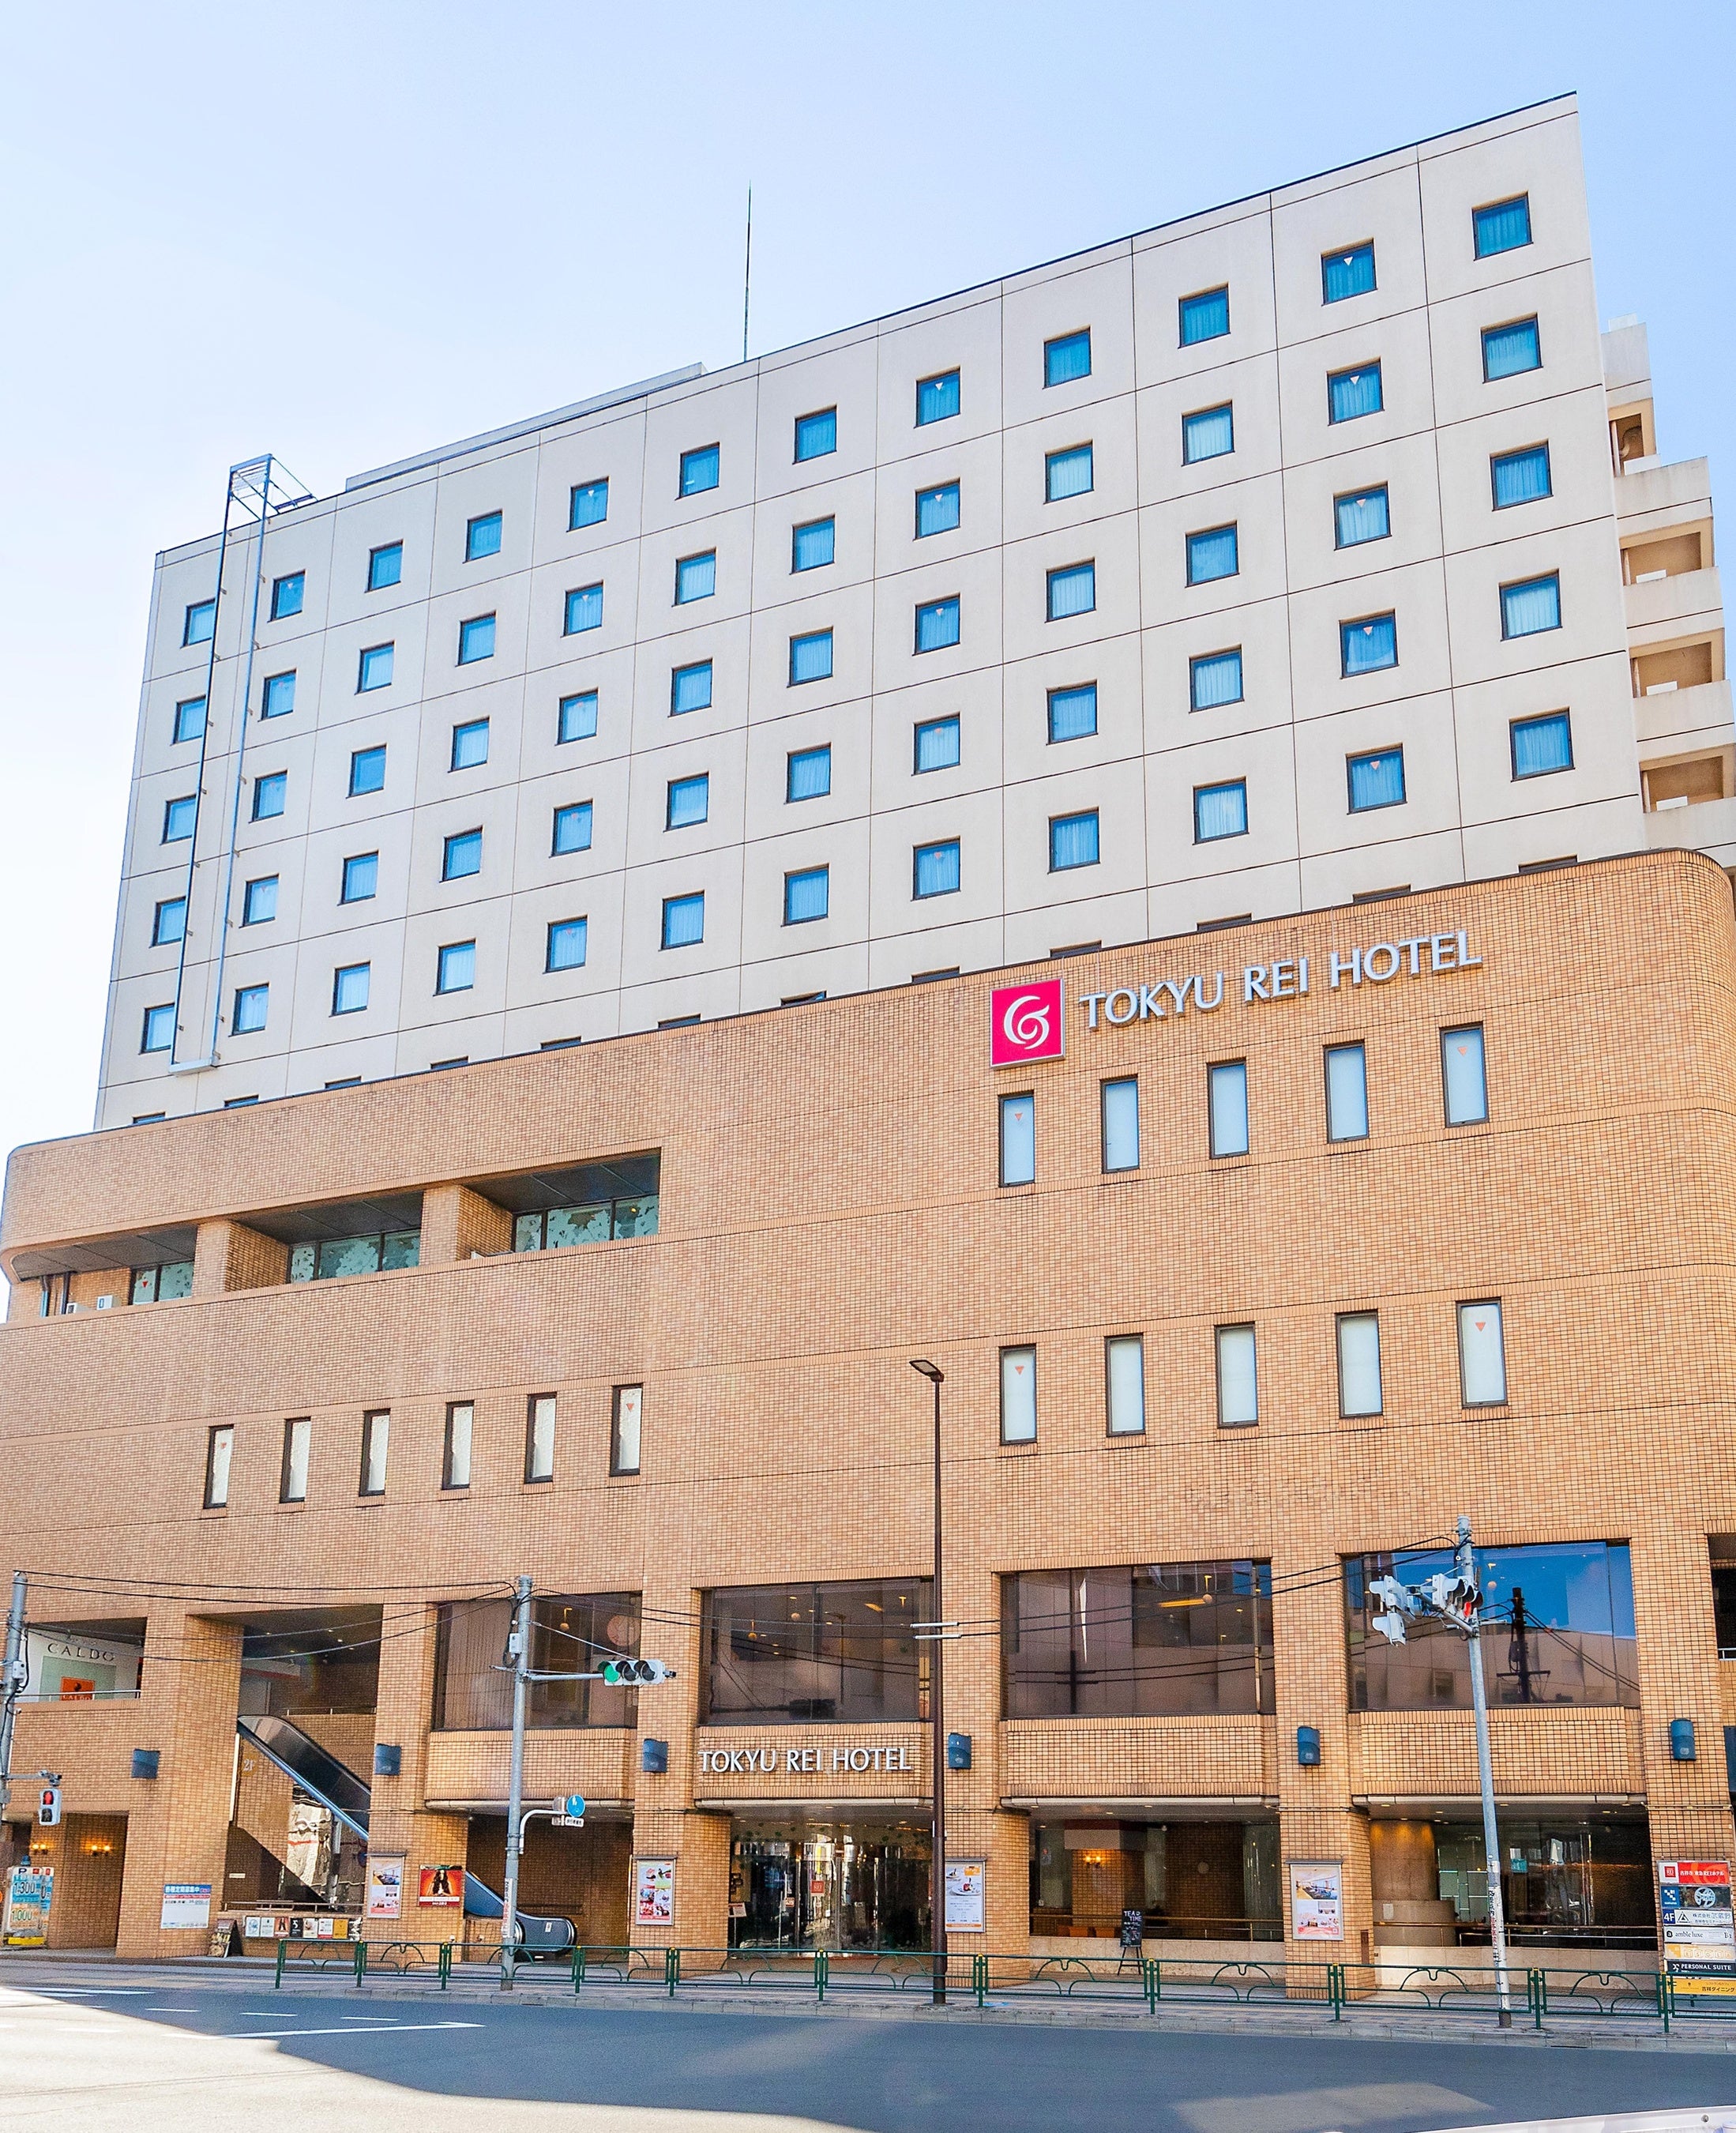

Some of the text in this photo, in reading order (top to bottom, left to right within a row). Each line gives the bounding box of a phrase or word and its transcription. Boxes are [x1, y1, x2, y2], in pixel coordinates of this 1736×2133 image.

[1079, 929, 1483, 1031] TOKYU REI HOTEL
[47, 1642, 115, 1662] CALDO
[698, 1747, 913, 1774] TOKYU REI HOTEL
[1663, 1913, 1675, 1922] 4F
